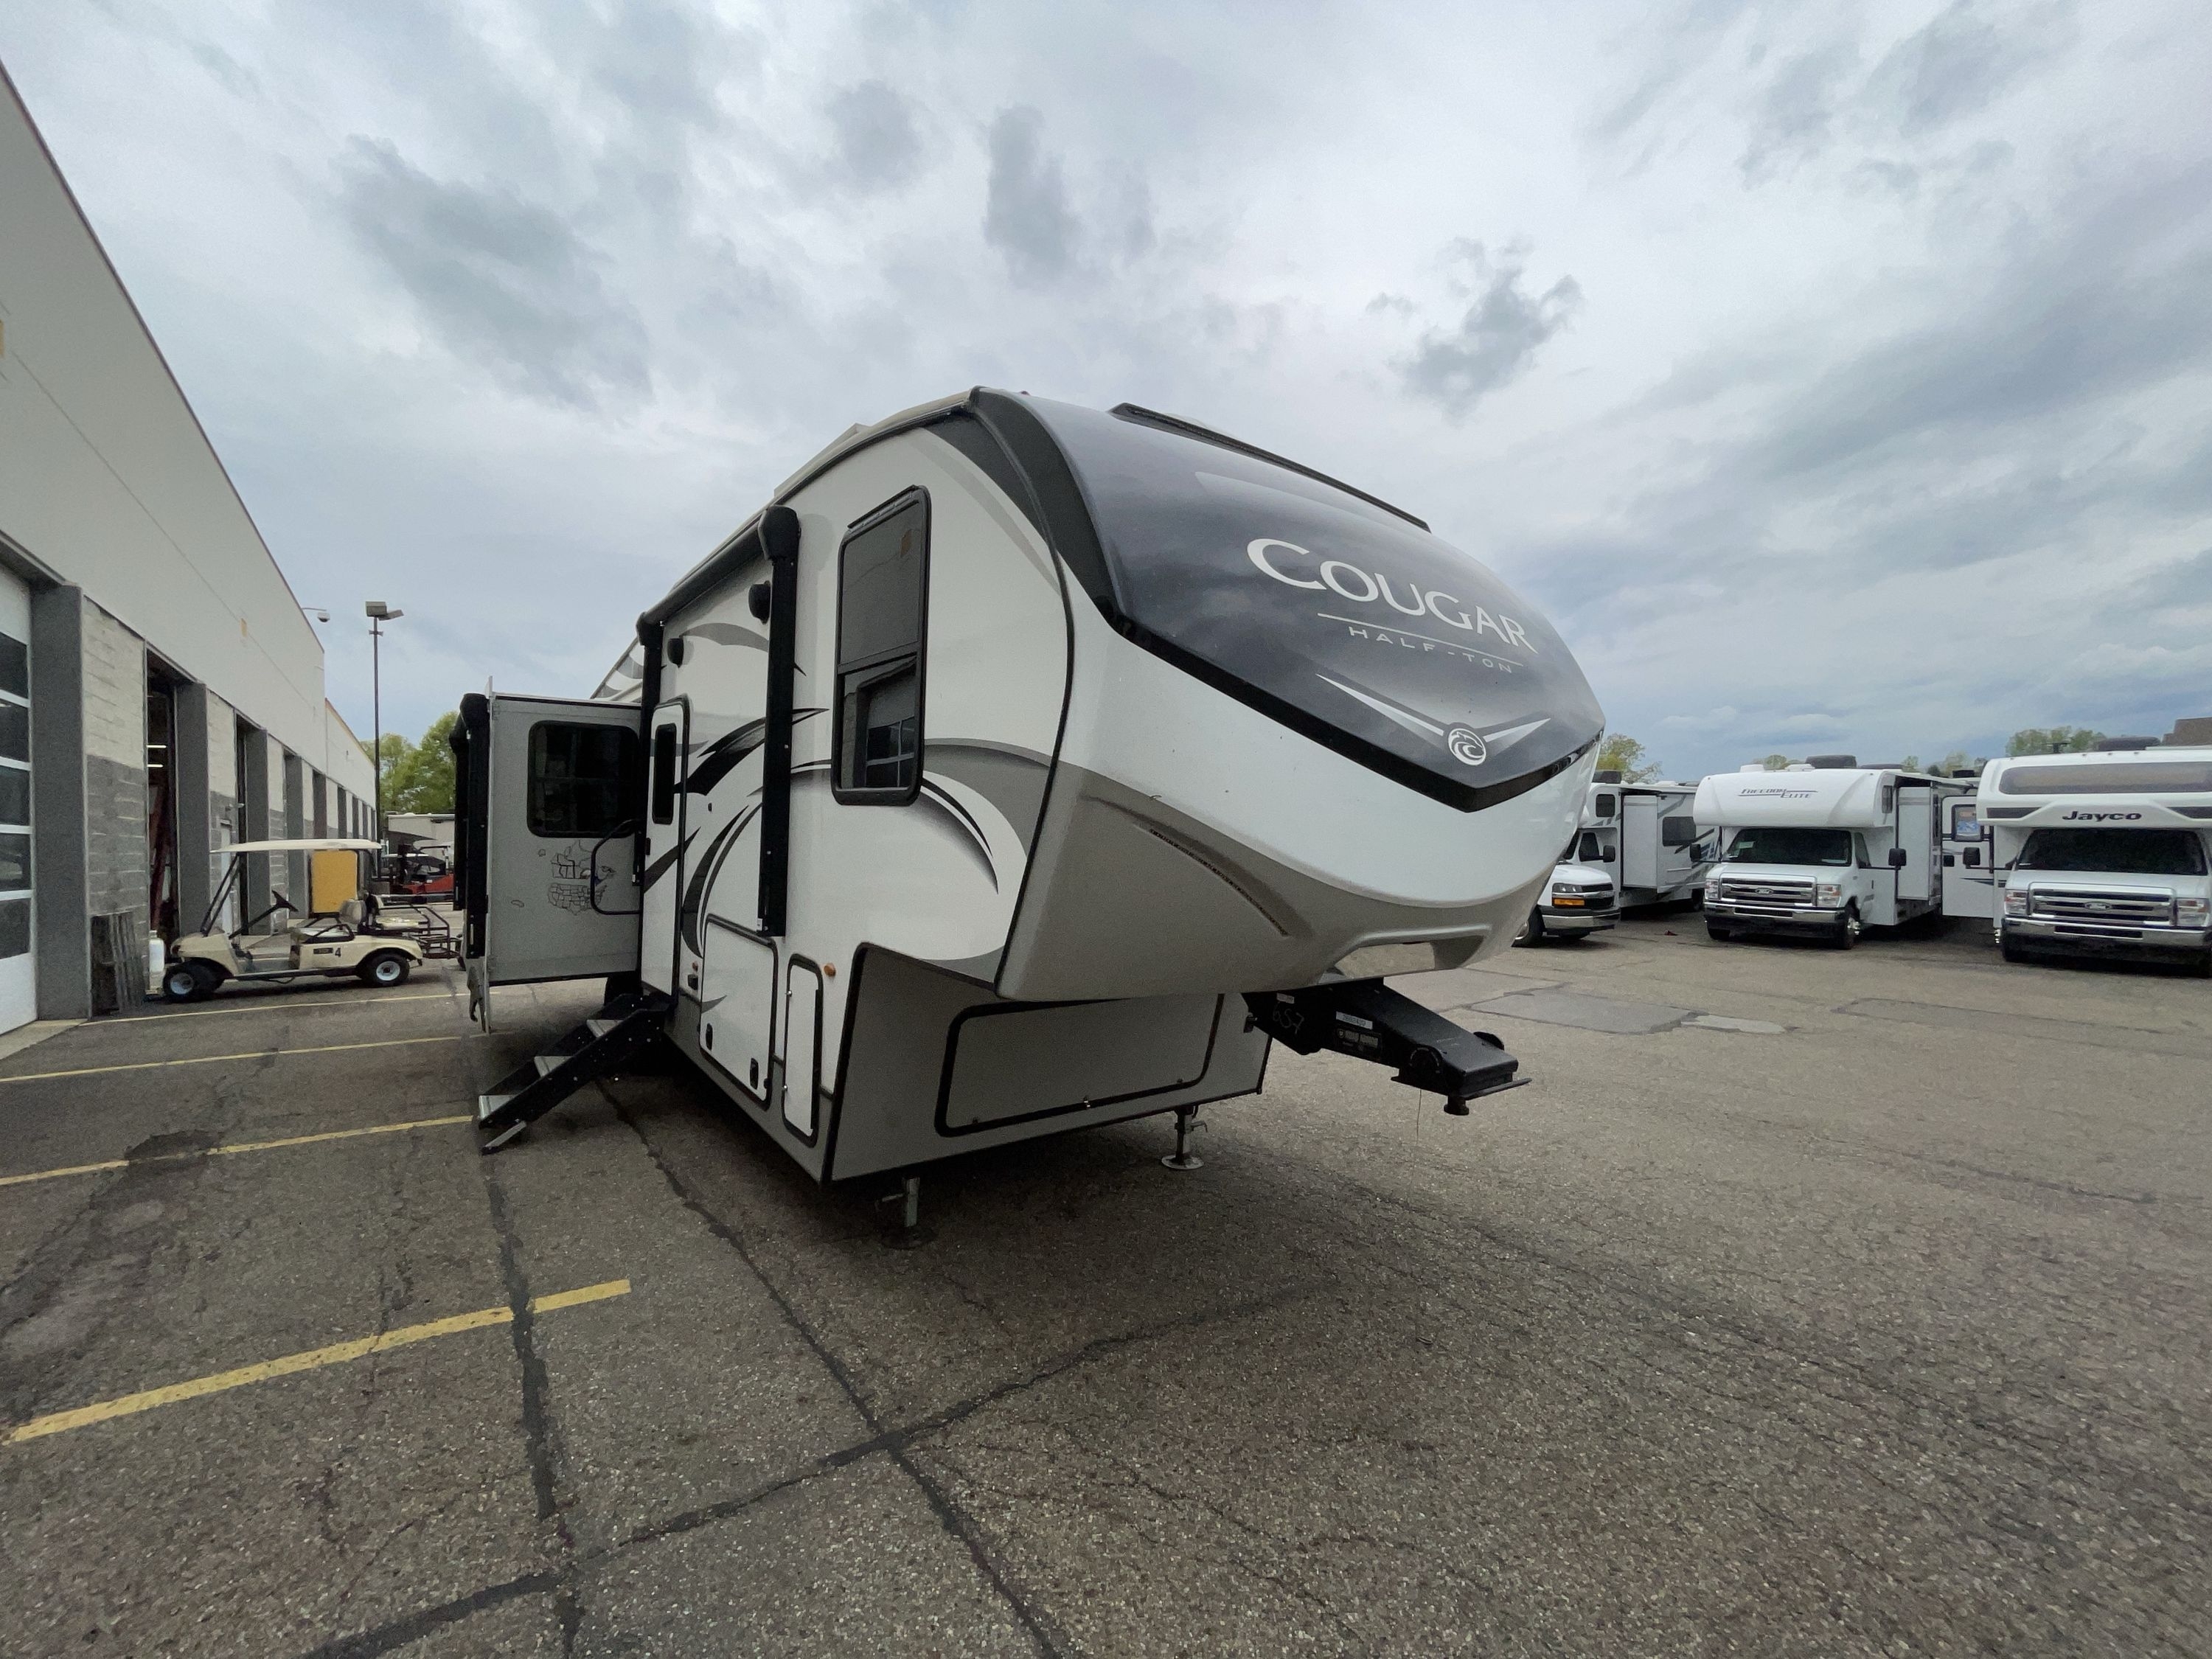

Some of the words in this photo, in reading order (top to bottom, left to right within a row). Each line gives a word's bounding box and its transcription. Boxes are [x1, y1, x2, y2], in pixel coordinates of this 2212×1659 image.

[1247, 538, 1539, 655] COUGAR
[2062, 810, 2143, 823] Jayco
[335, 947, 341, 958] 4
